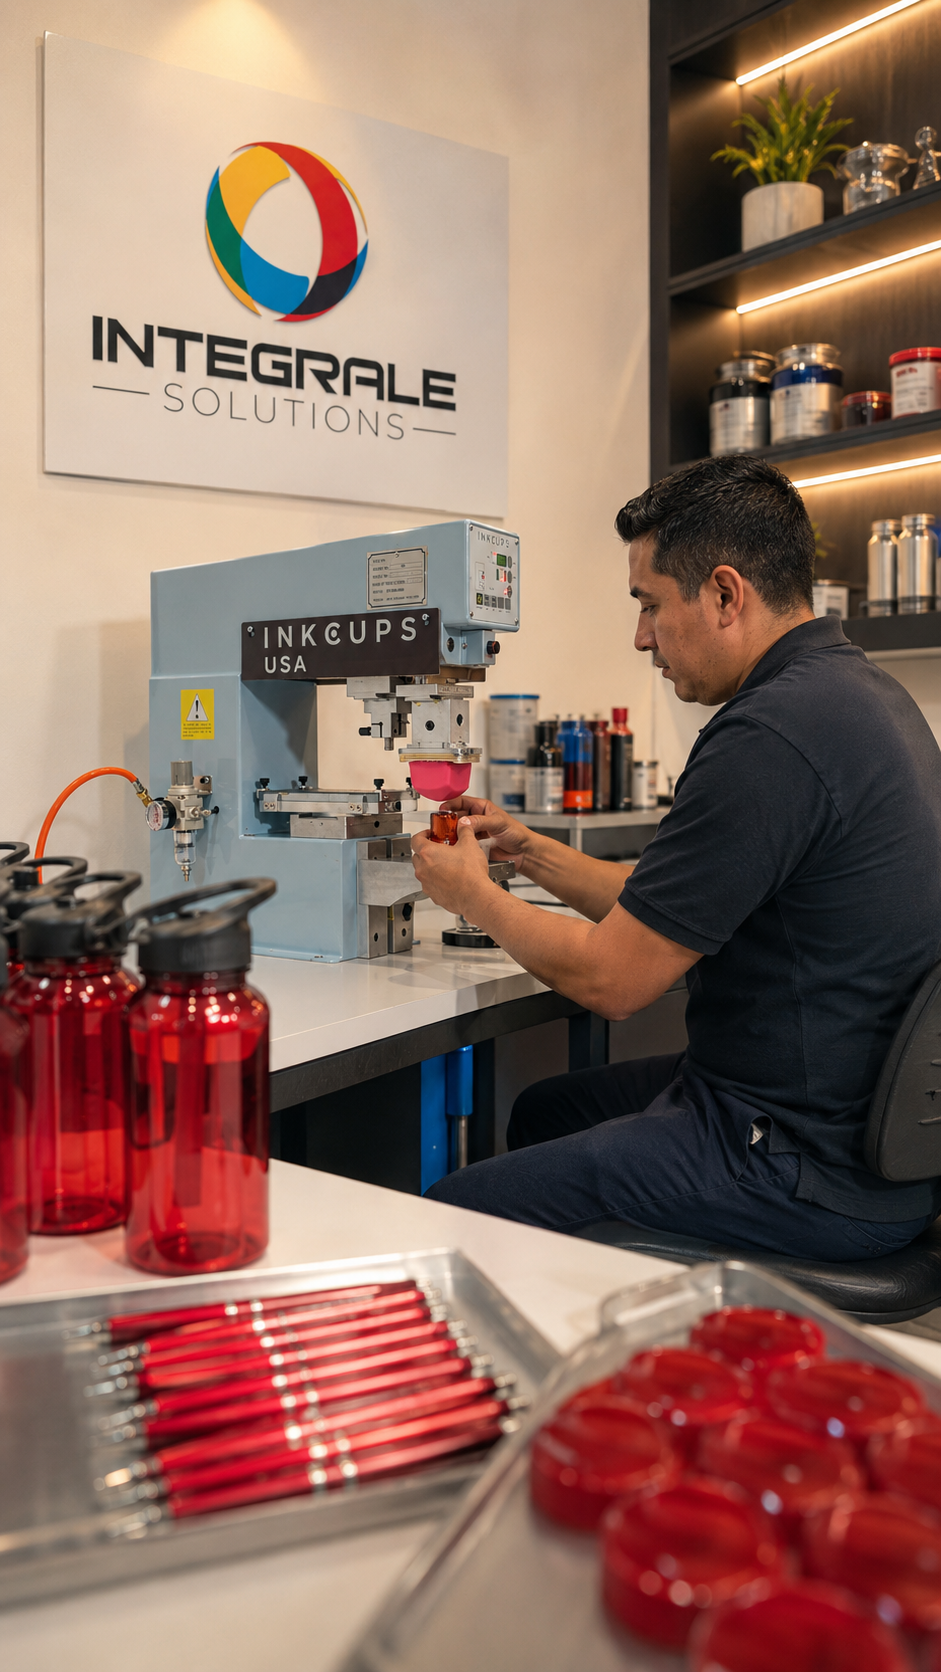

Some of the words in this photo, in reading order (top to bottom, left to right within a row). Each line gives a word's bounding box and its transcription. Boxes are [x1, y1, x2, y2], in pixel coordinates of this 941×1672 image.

[92, 315, 456, 411] INTEGRALE
[163, 382, 404, 440] SOLUTIONS
[264, 617, 417, 649] INKCUPS
[264, 655, 307, 674] USA
